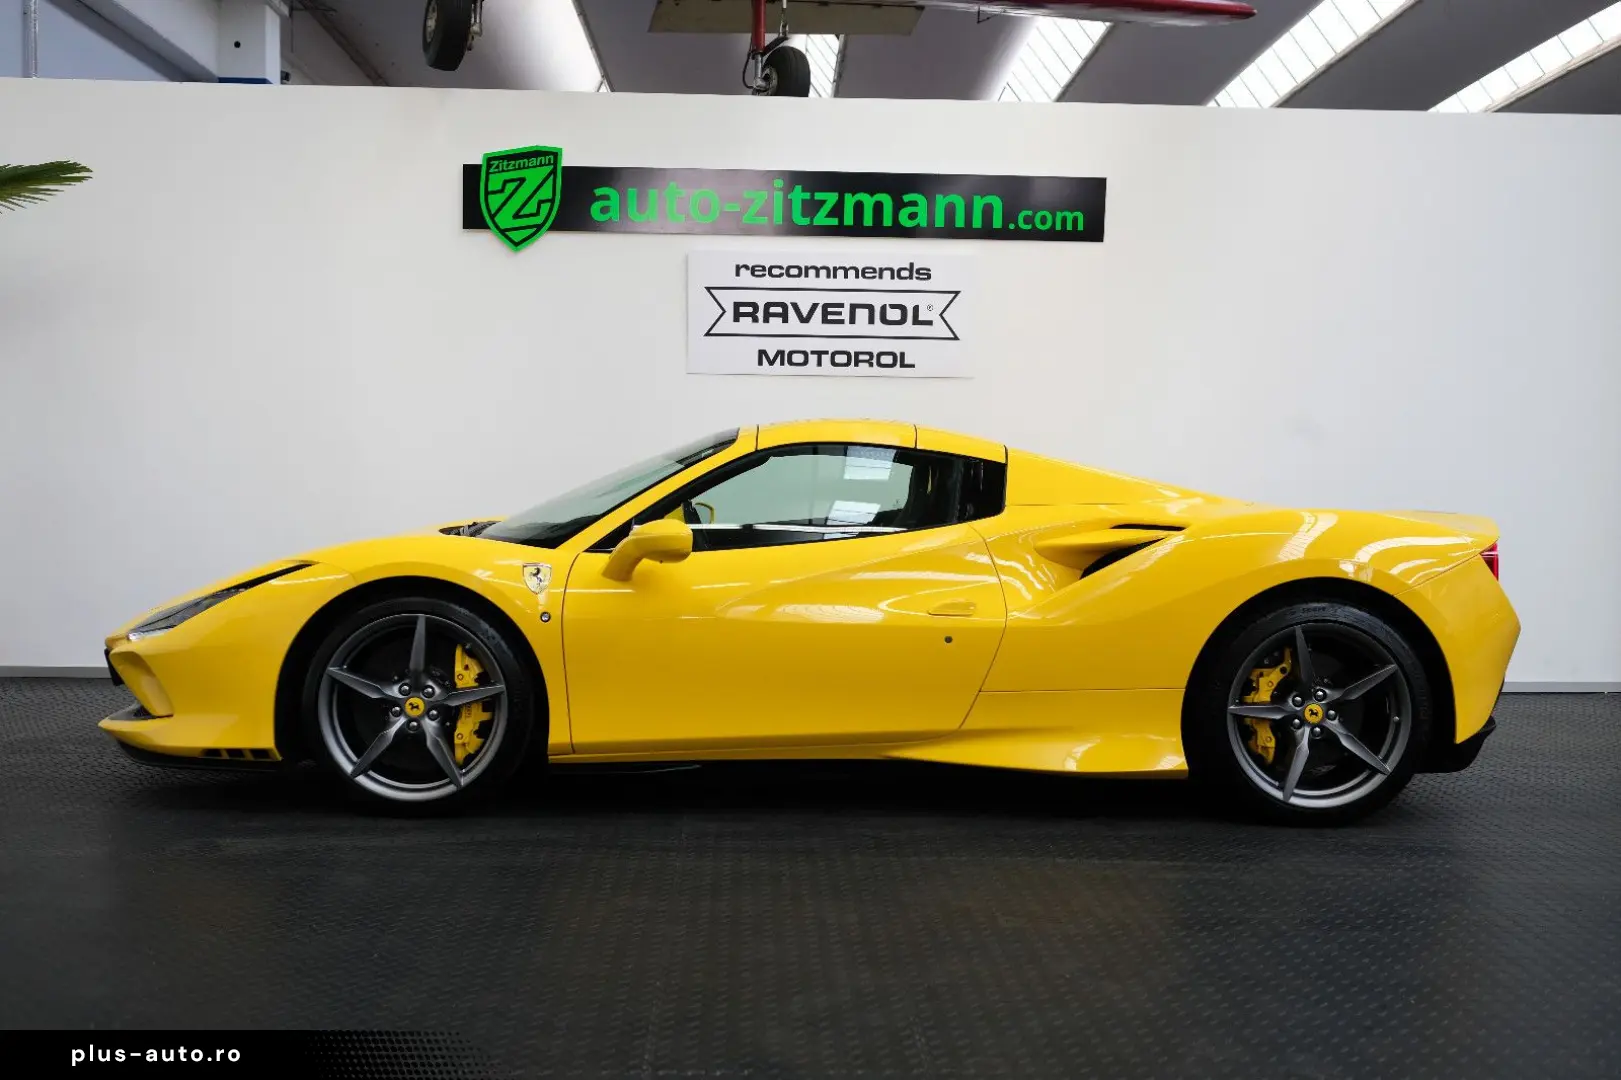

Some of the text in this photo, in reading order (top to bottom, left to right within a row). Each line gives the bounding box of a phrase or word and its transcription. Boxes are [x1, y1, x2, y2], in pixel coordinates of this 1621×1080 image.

[489, 155, 554, 173] Zitzmann
[591, 180, 1084, 231] auto-zitzmann.com
[736, 262, 931, 280] recommends
[758, 349, 915, 368] MOTOROL
